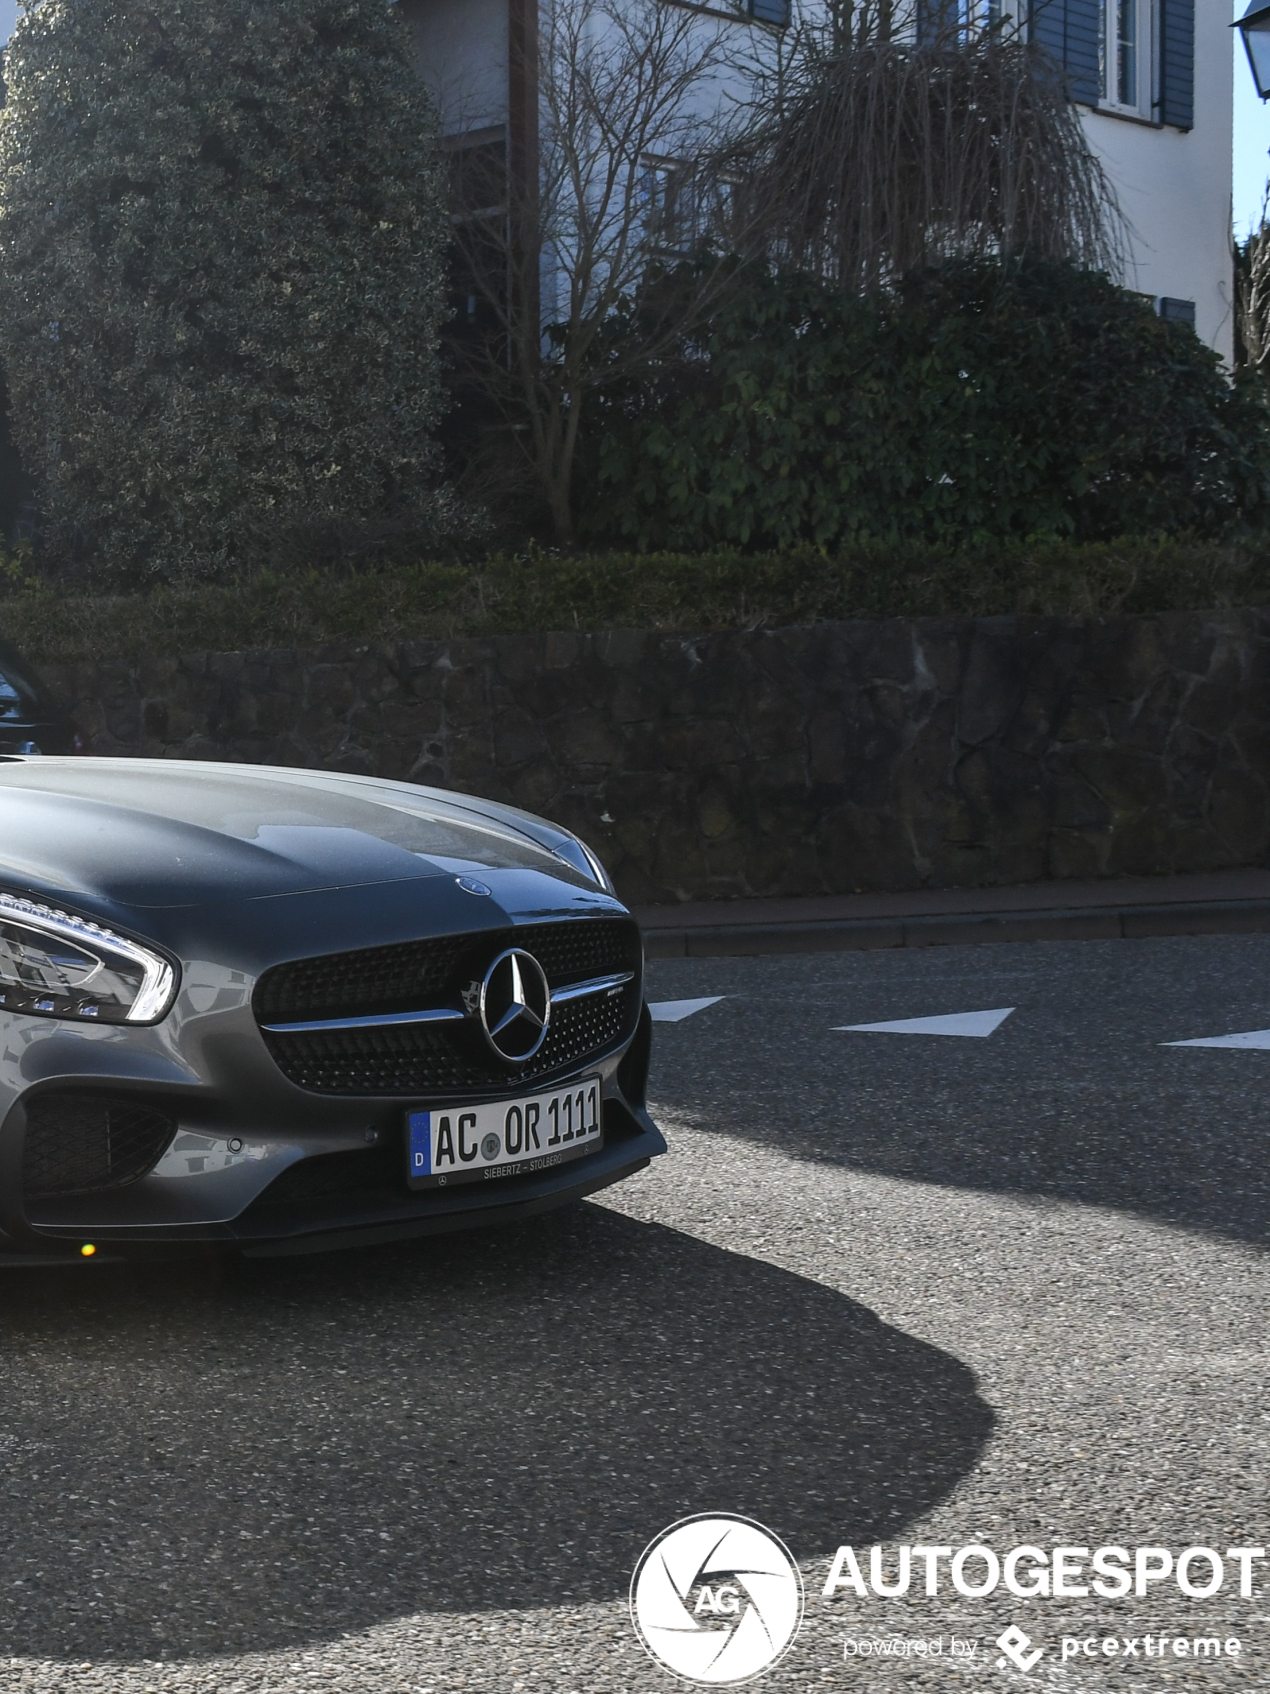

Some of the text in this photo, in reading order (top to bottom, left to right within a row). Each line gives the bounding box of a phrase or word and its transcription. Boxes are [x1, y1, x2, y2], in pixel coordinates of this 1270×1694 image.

[435, 1086, 599, 1167] AC OR 1111
[414, 1152, 424, 1167] D
[483, 1164, 521, 1179] SIEBERTZ
[529, 1154, 562, 1171] STOLBERG
